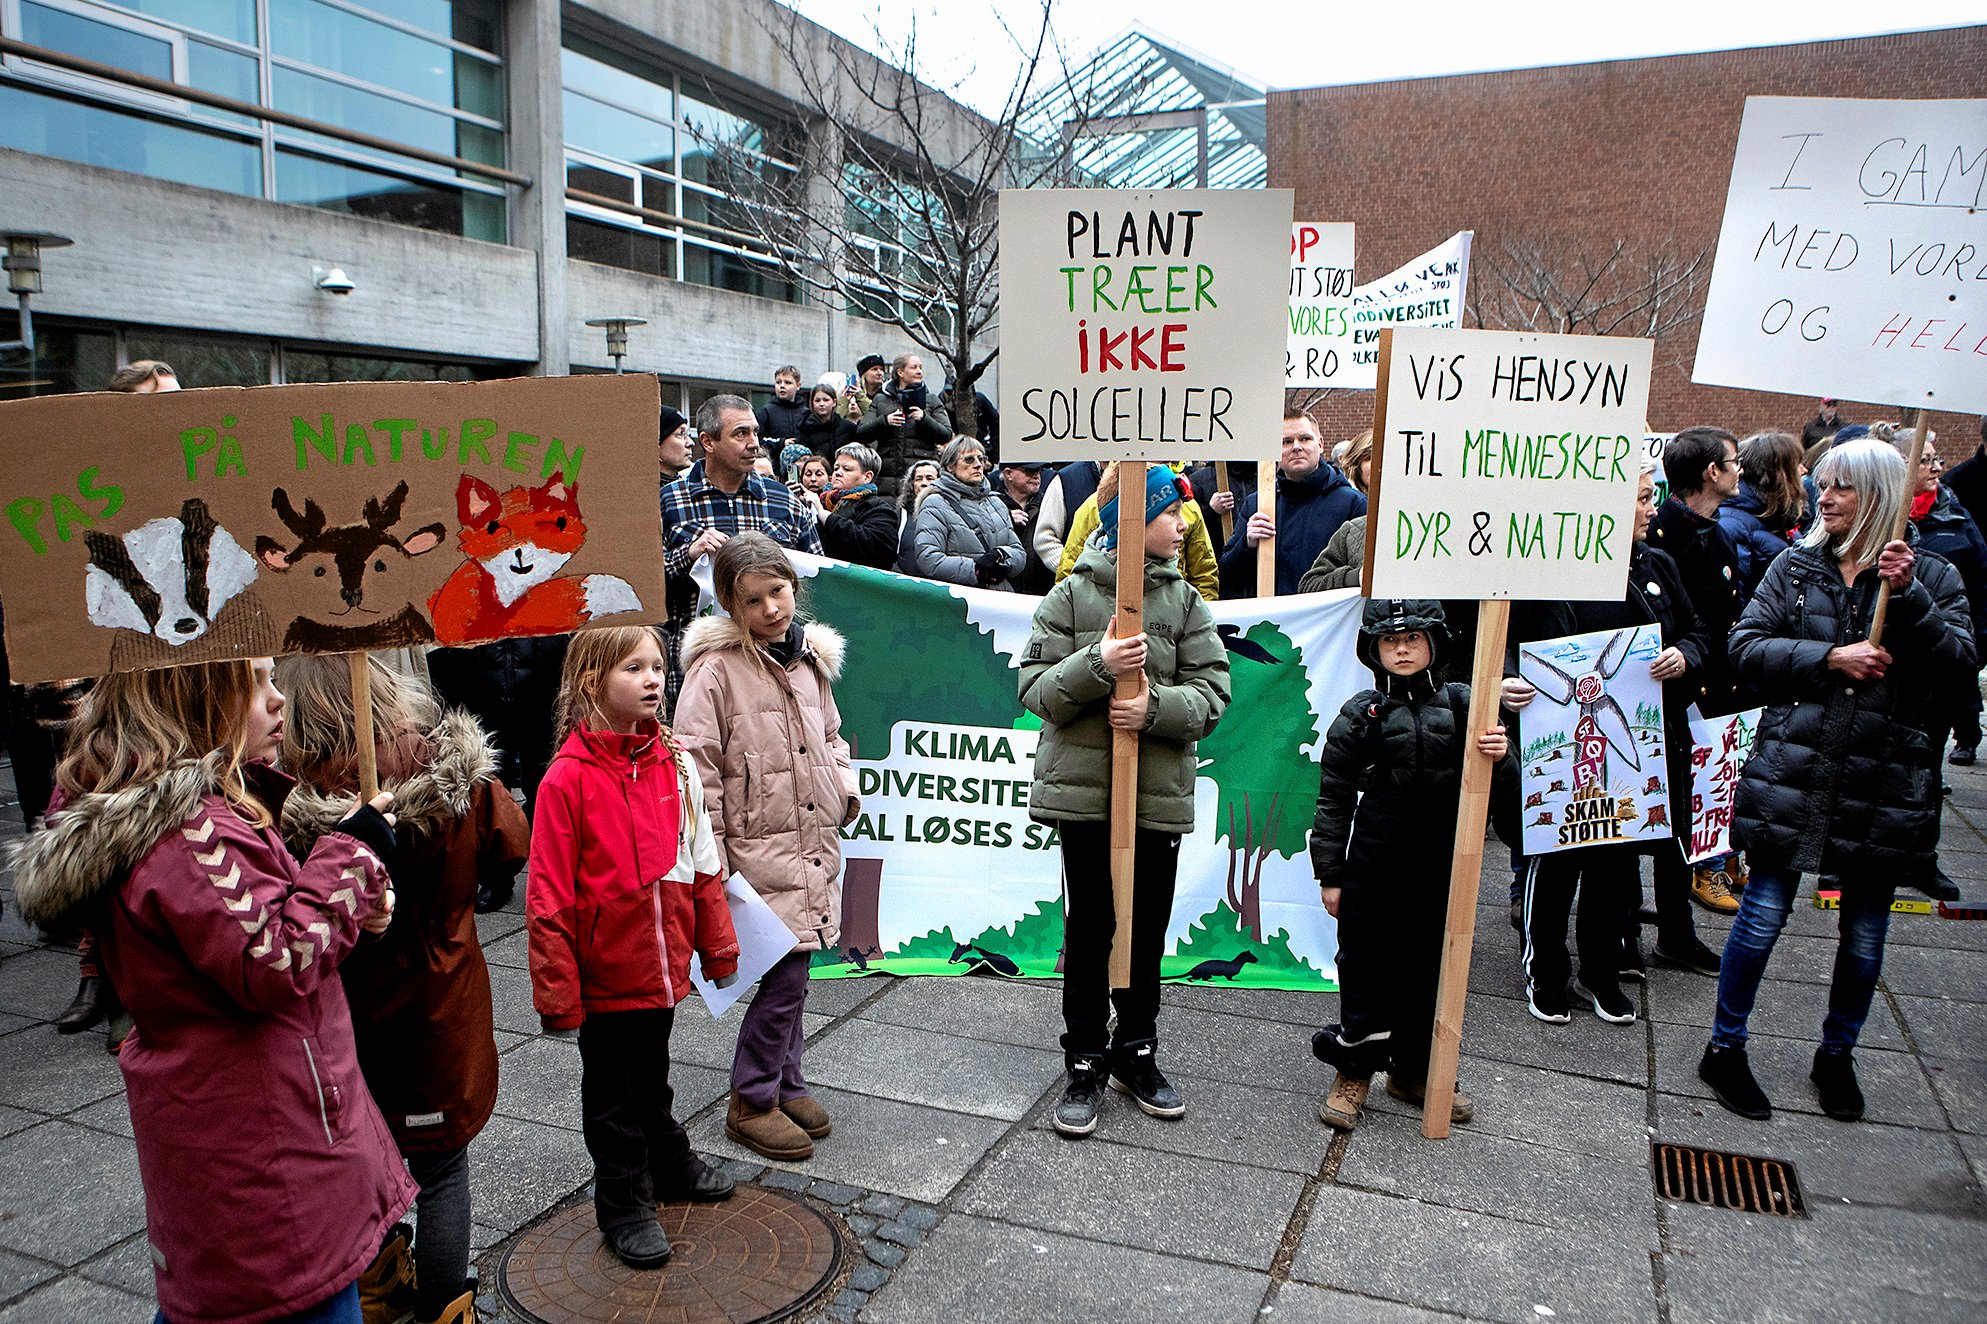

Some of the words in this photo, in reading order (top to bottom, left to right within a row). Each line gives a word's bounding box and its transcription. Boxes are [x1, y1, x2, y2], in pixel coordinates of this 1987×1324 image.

[1769, 133, 1823, 190] I
[1067, 210, 1203, 259] PLANT
[1754, 221, 1859, 271] MED
[1060, 264, 1217, 313] TRÆER
[1313, 267, 1354, 298] STØJ
[1288, 305, 1349, 337] VORES
[1761, 298, 1830, 342] OG
[1307, 348, 1339, 379] RO
[1492, 355, 1628, 408] HENSYN
[1021, 386, 1234, 442] SOLCELLER
[1462, 429, 1630, 482] MENNESKER
[3, 466, 125, 555] PAS
[180, 416, 248, 481] PÅ
[293, 412, 586, 487] NATUREN
[1396, 510, 1452, 561] DYR
[1468, 511, 1492, 556] &
[1507, 512, 1615, 563] NATUR
[1149, 622, 1172, 632] EQPE
[904, 728, 1016, 764] KLIMA
[1579, 720, 1591, 739] SF
[859, 767, 1034, 808] DIVERSITE
[1564, 797, 1614, 823] SKAM
[905, 815, 1013, 848] LØSES
[1558, 819, 1622, 844] STØTTE
